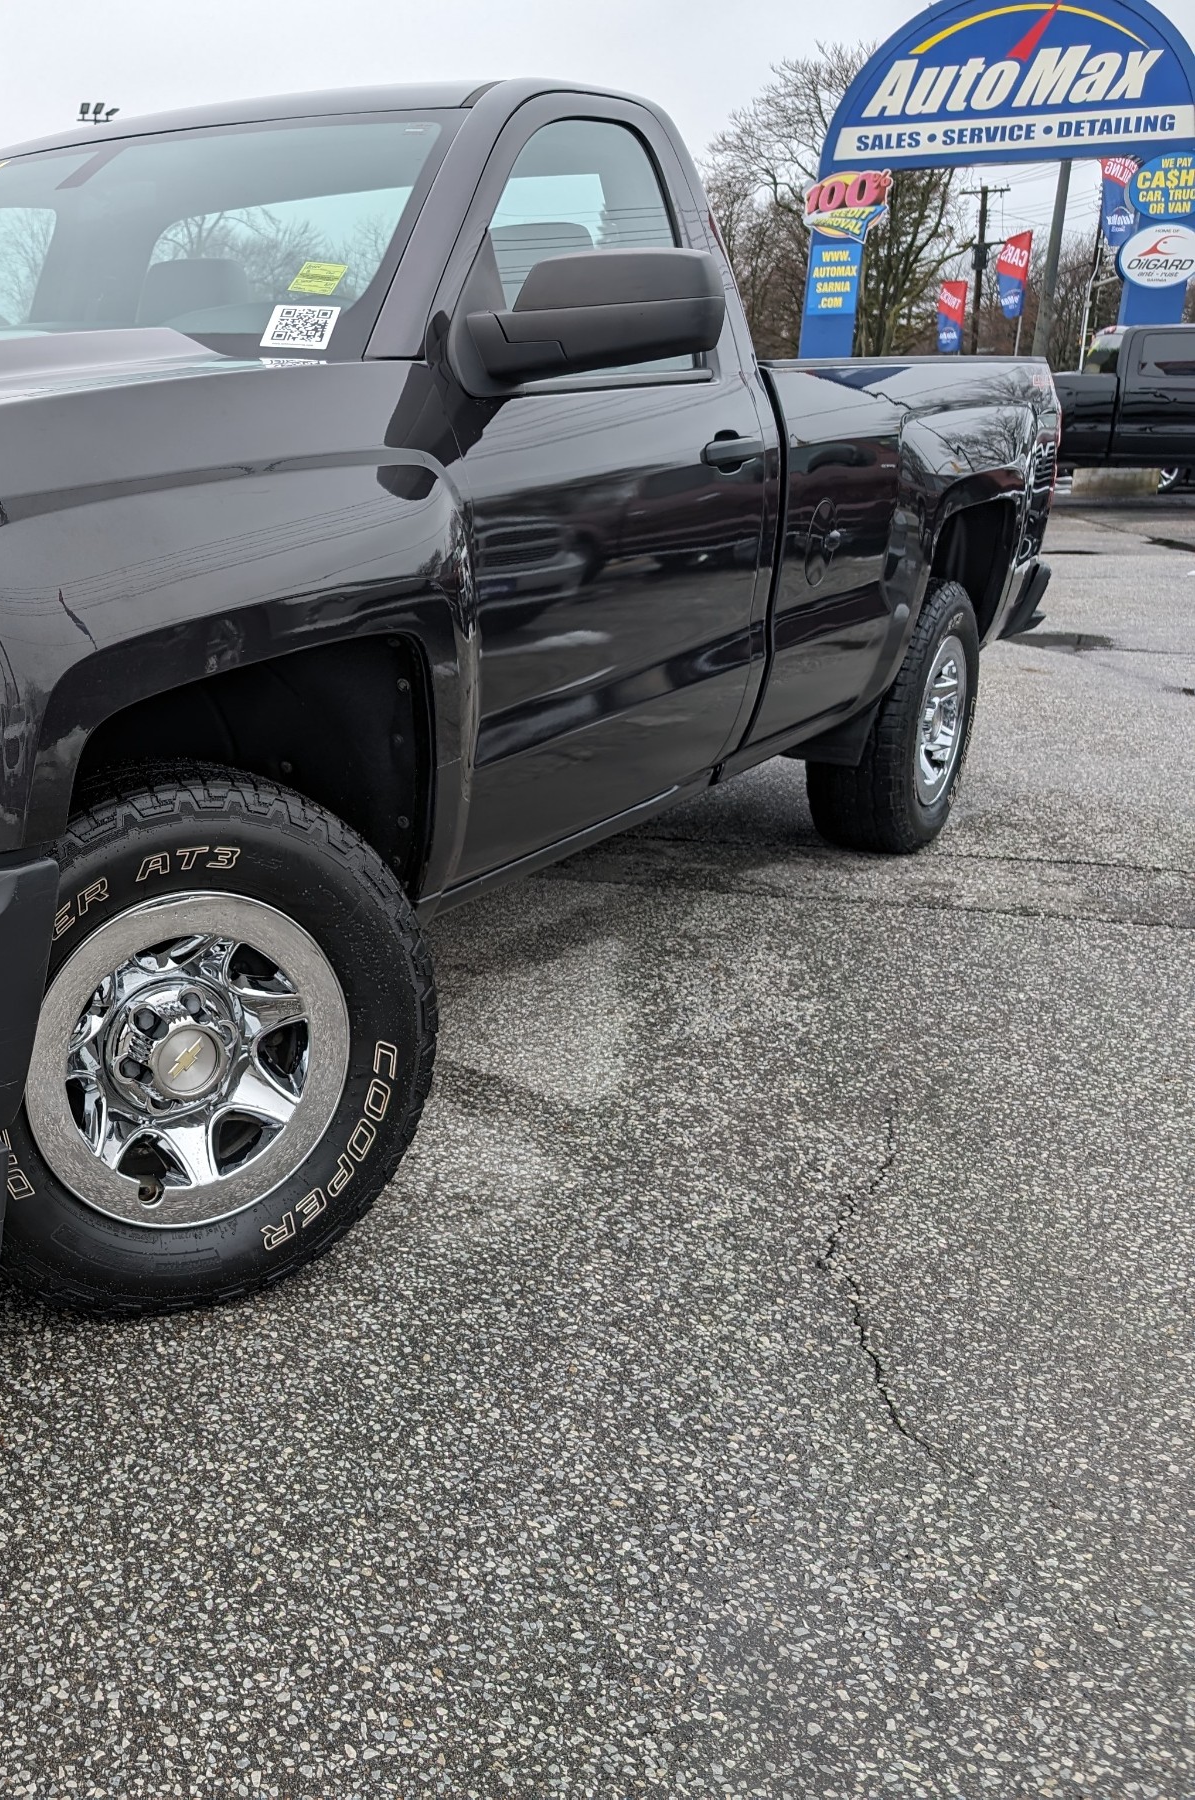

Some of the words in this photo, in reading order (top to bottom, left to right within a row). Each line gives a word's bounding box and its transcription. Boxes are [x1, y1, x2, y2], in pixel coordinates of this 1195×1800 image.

[861, 45, 1164, 118] AutoMax
[856, 131, 921, 151] SALES
[941, 123, 1036, 146] SERVICE
[1056, 114, 1176, 138] DETAILING
[1161, 158, 1175, 169] WE
[1176, 156, 1193, 168] PAY
[1136, 169, 1195, 189] CA$H
[806, 169, 892, 214] 100%
[1168, 188, 1195, 201] TRUC
[1149, 202, 1165, 214] OR
[1167, 201, 1192, 213] VAN
[813, 265, 857, 278] AUTOMAX
[816, 281, 851, 293] SARNIA
[818, 296, 843, 309] .COM
[135, 846, 241, 882] AT3
[260, 1040, 397, 1251] COOPER
